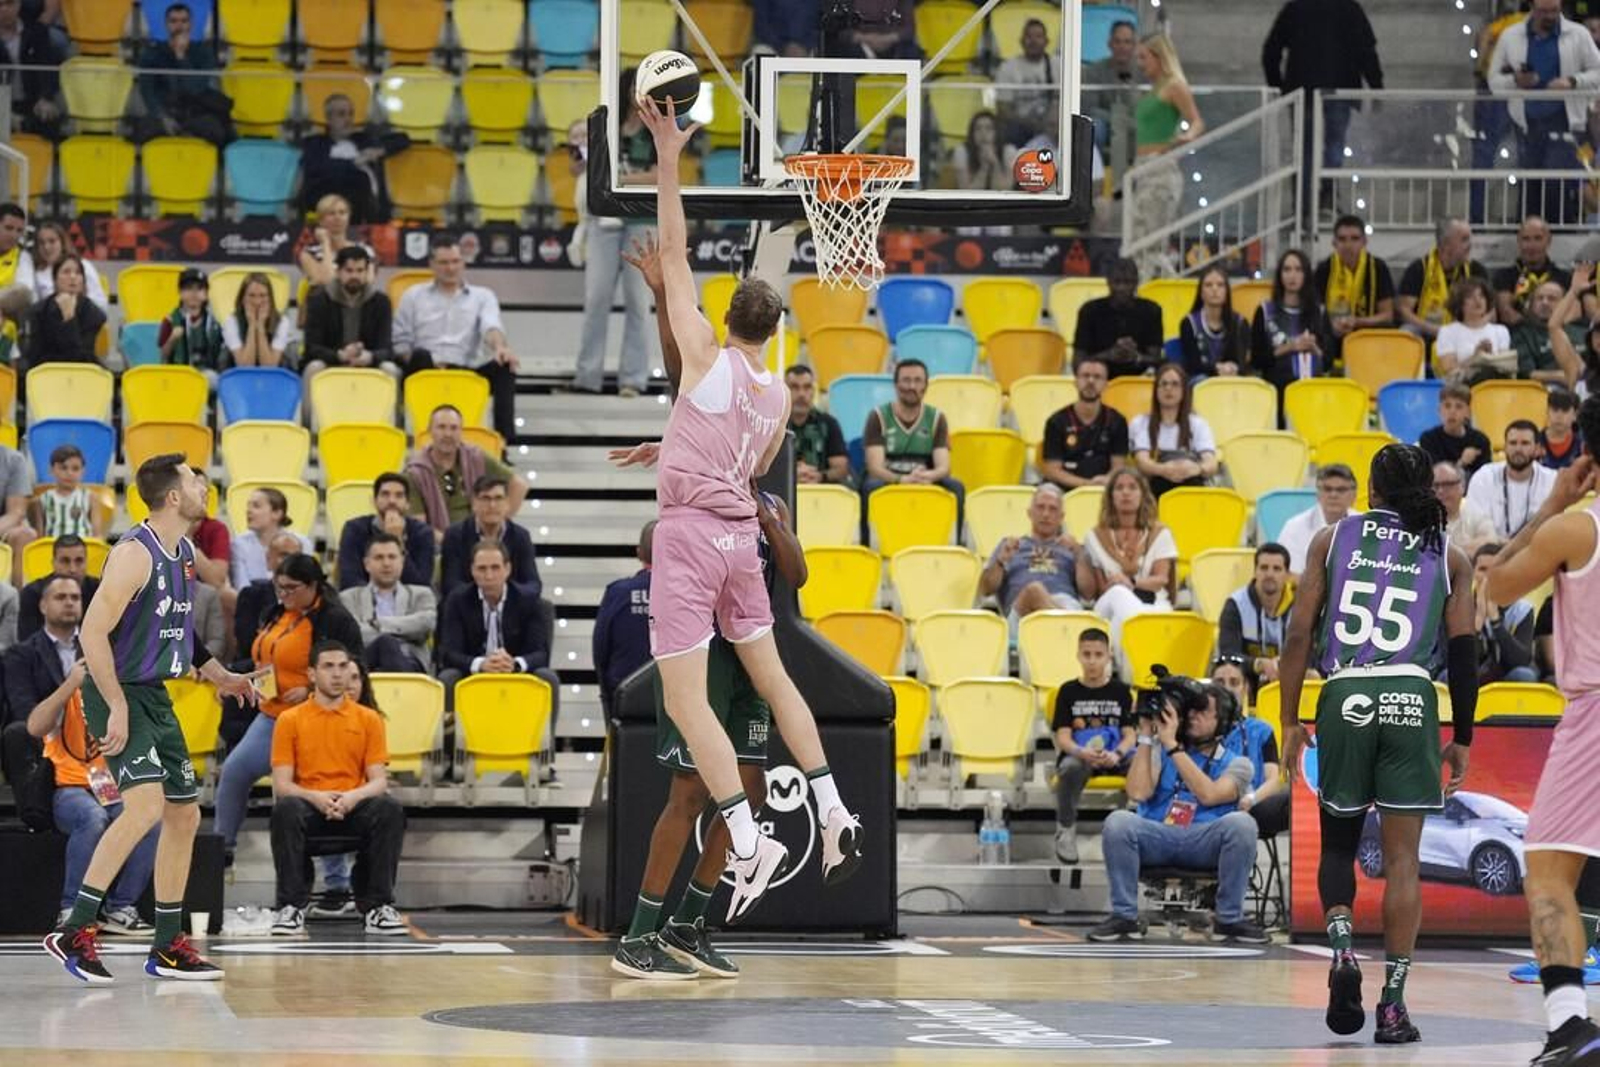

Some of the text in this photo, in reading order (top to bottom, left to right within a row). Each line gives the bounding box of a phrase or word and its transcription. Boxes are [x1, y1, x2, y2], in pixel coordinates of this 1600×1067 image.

[713, 532, 735, 550] vdf
[1362, 520, 1420, 549] Perry
[1334, 579, 1418, 652] 55
[1379, 692, 1424, 706] COSTA
[1379, 704, 1423, 717] DEL SOL
[1378, 714, 1422, 727] MÁLAGA
